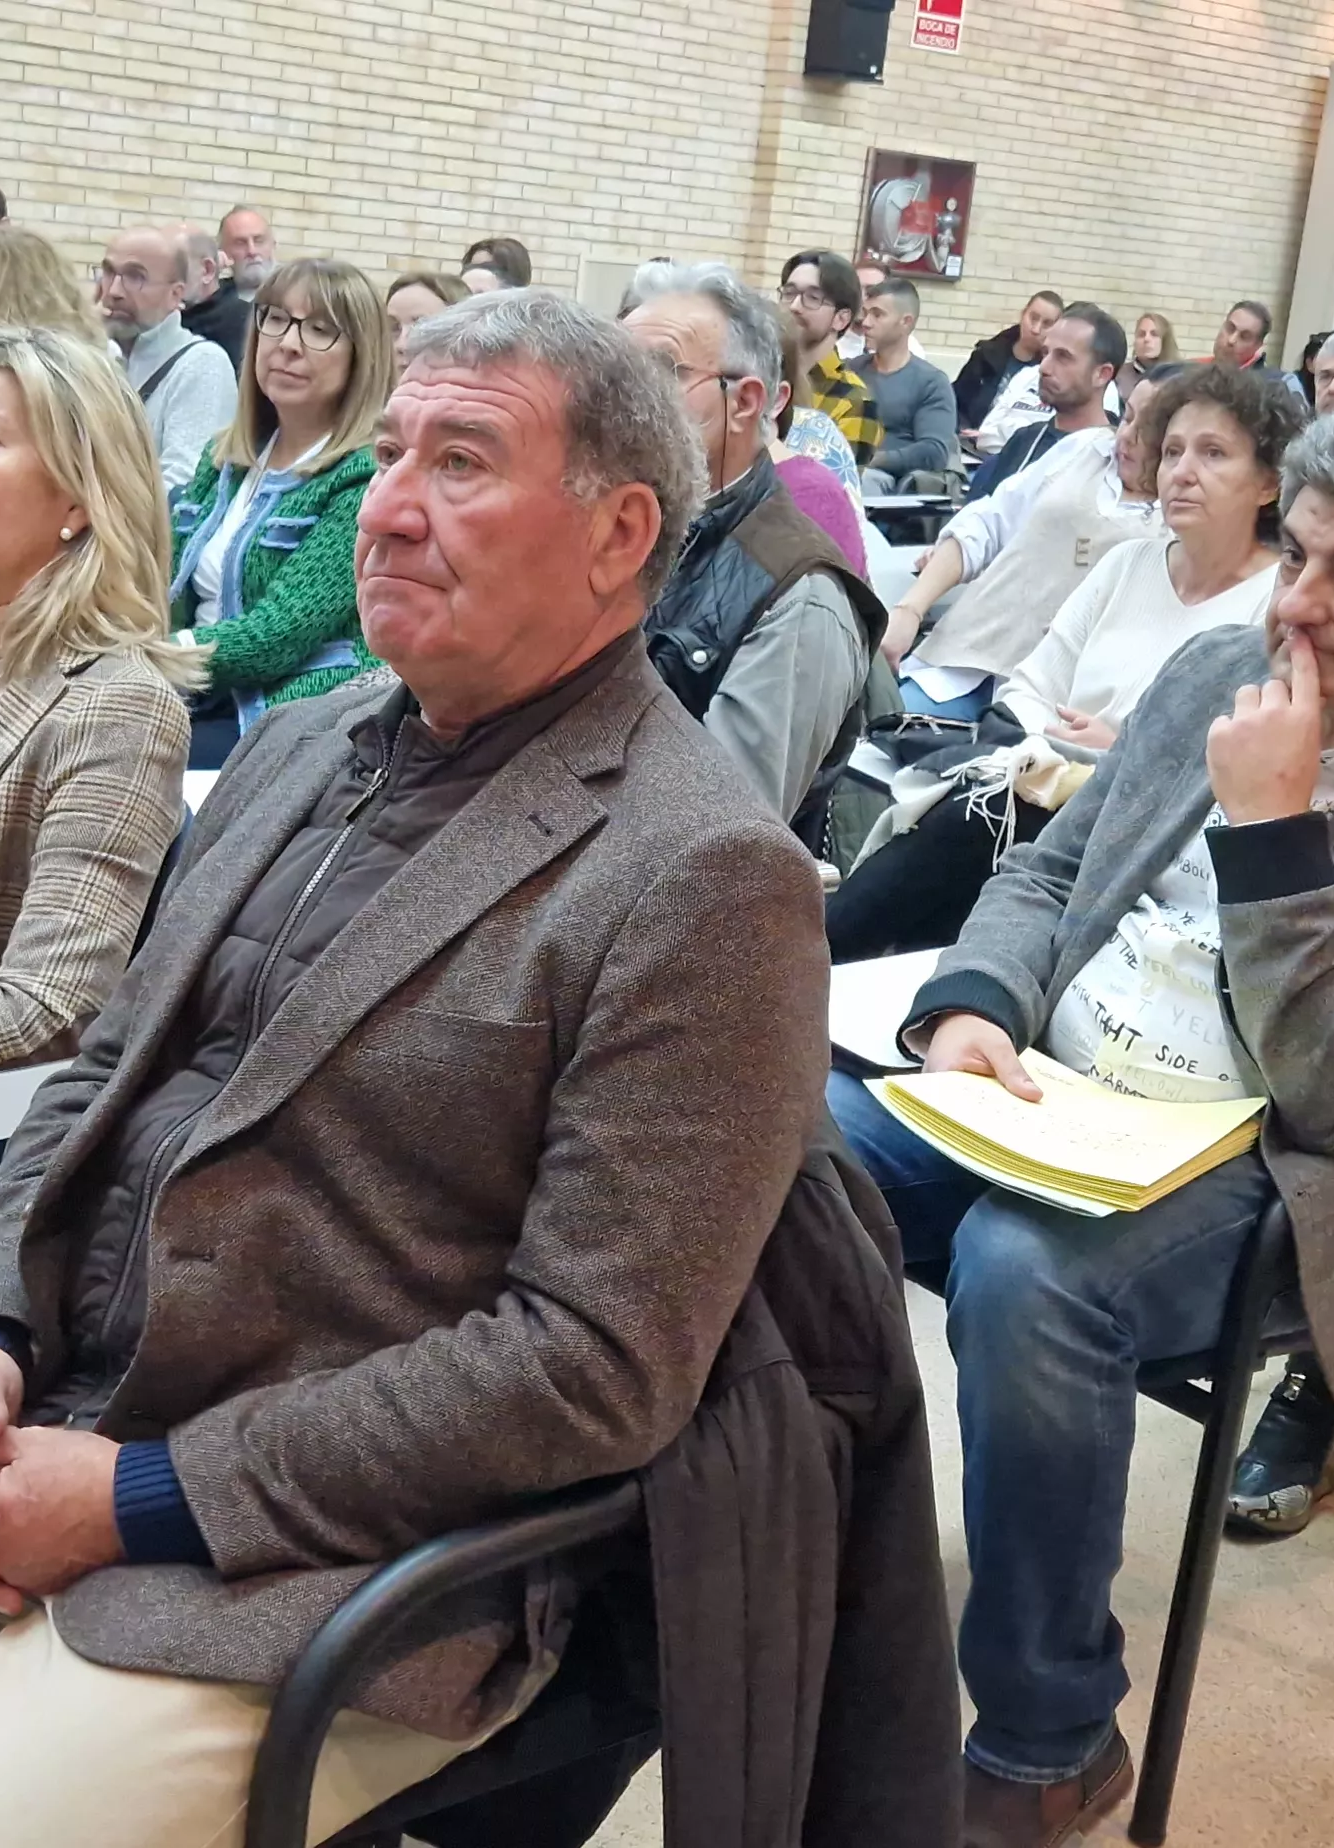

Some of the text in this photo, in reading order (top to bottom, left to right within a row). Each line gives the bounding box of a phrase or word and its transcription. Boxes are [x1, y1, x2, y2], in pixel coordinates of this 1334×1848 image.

[919, 19, 957, 36] BOCA DE
[916, 33, 956, 49] INCENDIO
[1074, 537, 1091, 567] E
